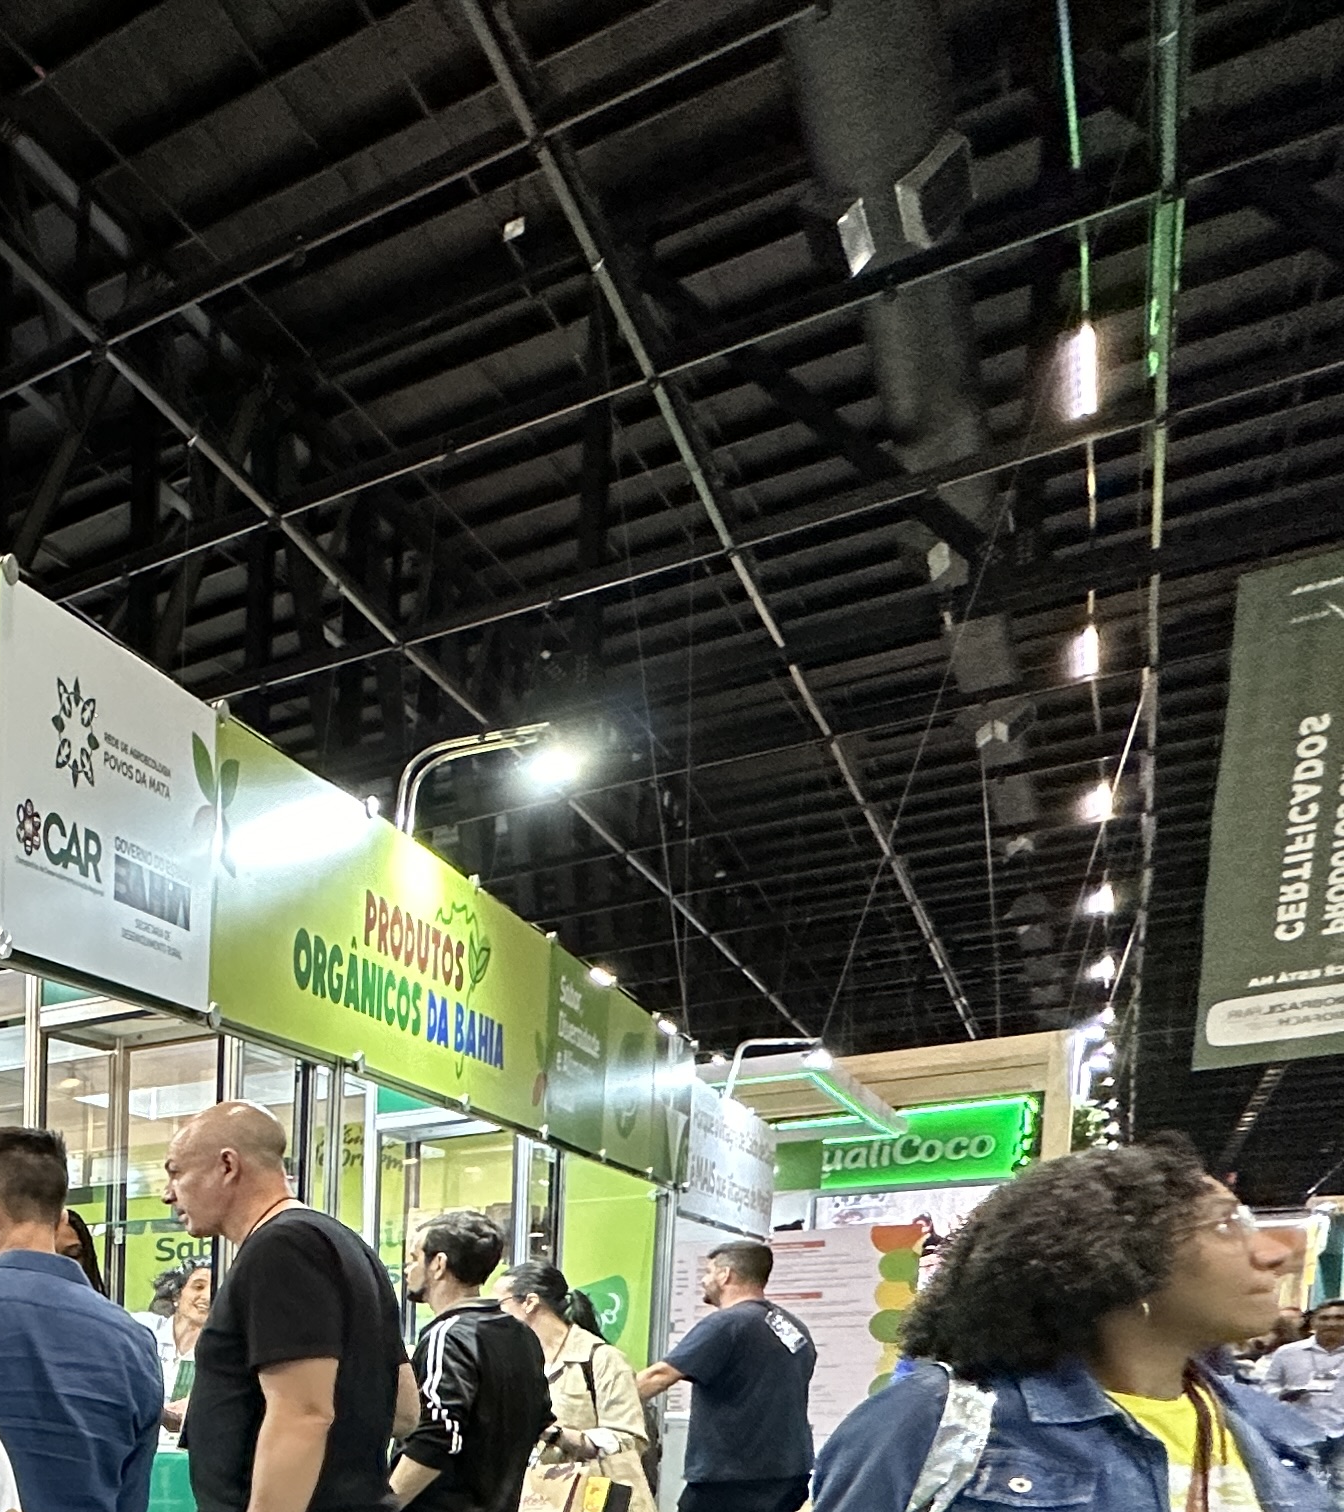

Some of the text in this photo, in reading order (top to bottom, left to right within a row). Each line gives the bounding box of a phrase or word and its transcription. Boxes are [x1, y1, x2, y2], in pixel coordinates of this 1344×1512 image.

[103, 751, 171, 800] POVOS DA MATA
[43, 812, 102, 884] CAR
[364, 889, 465, 992] PRODUTOS
[293, 928, 423, 1037] ORGÂNICOS
[426, 988, 449, 1049] DA
[454, 1001, 504, 1071] BAHIA
[820, 1134, 996, 1180] ualiCoco
